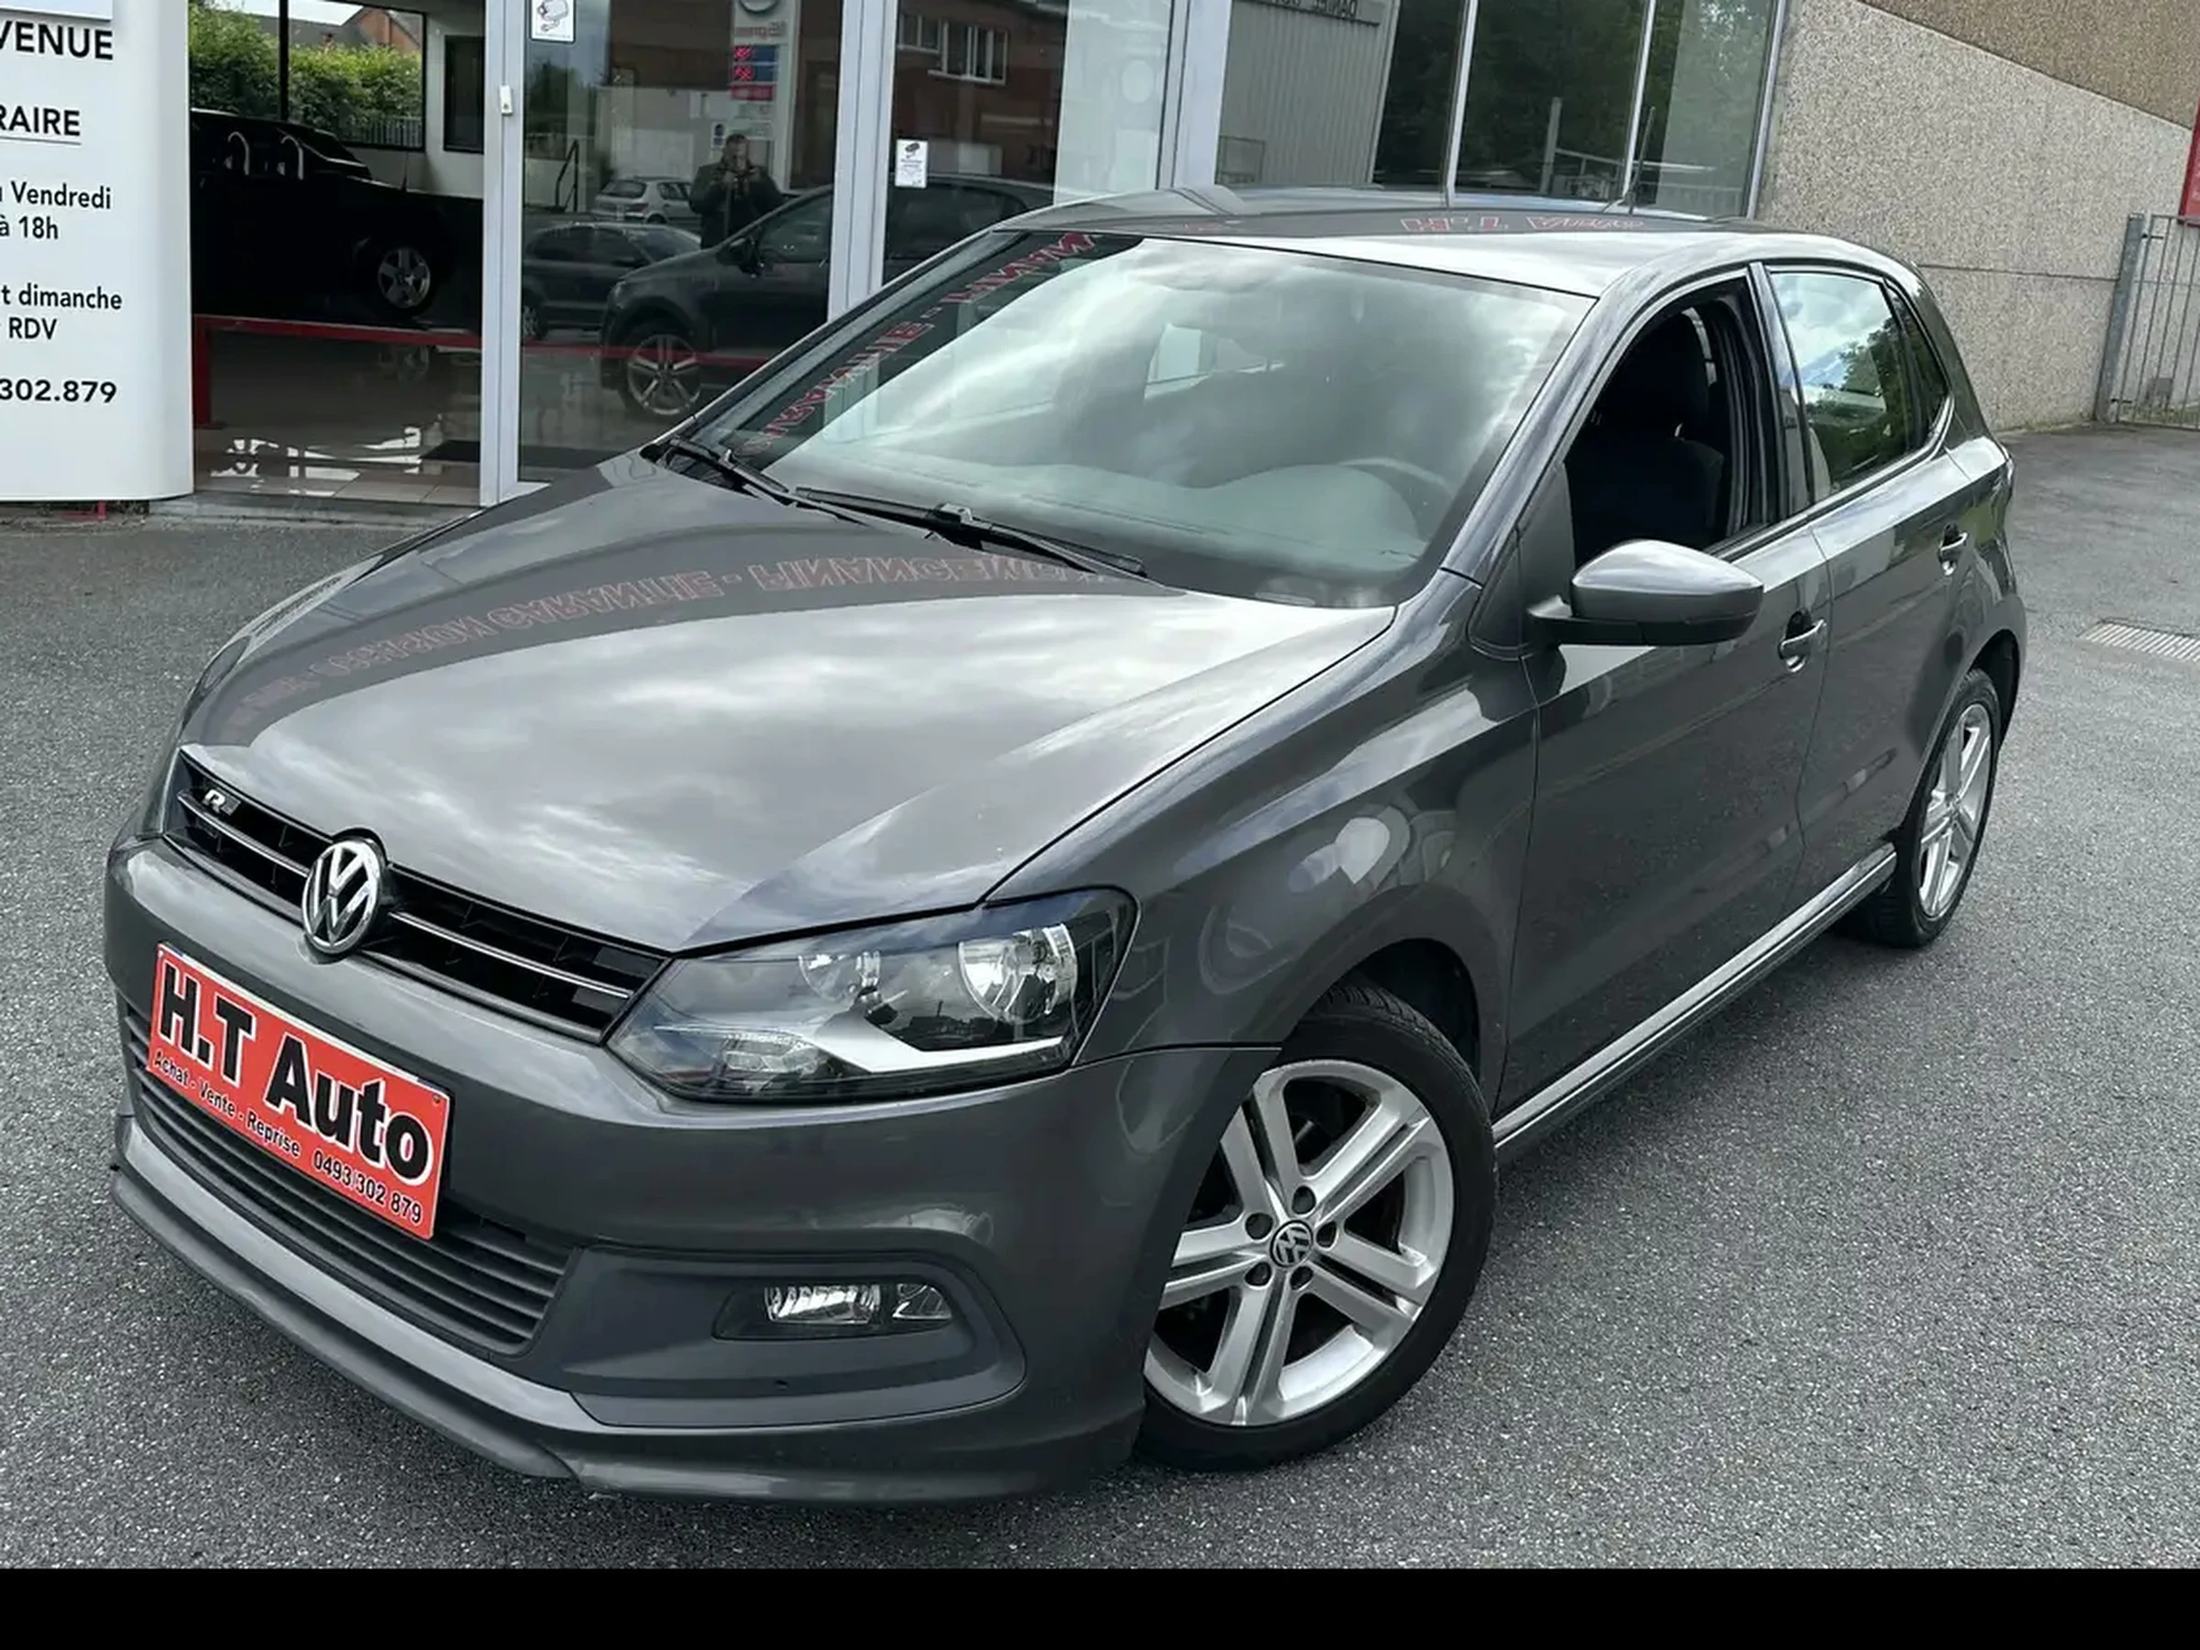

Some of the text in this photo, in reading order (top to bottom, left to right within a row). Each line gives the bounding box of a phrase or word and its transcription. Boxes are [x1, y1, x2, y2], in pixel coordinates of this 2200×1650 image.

[11, 180, 111, 209] Vendredi
[0, 214, 59, 239] à 18h
[18, 282, 123, 310] dimanche
[9, 317, 57, 340] RDV
[0, 378, 117, 403] 302.879
[158, 958, 434, 1185] H.T Auto
[153, 1050, 189, 1087] Achat
[200, 1075, 236, 1118] Vente
[247, 1109, 301, 1158] Reprise
[390, 1191, 422, 1225] 879
